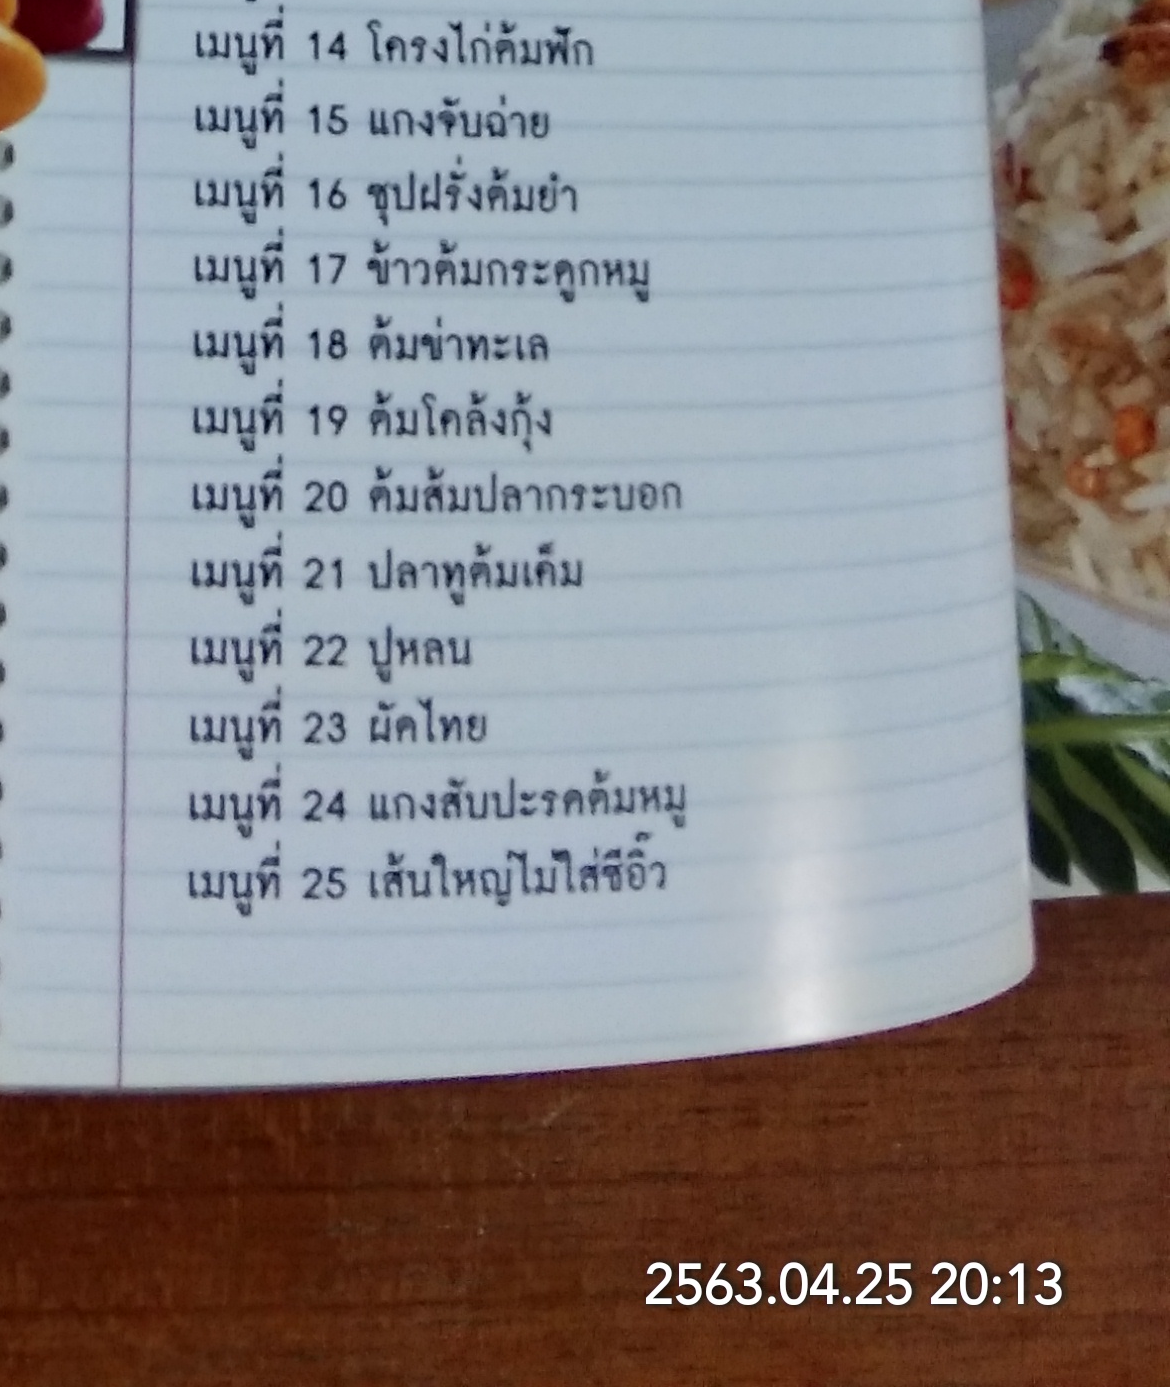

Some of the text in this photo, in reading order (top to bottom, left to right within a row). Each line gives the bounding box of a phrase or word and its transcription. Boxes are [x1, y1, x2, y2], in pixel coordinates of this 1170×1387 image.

[195, 4, 594, 76] เมนูที่ 14 โครงไก่ต้มฟัก
[194, 78, 550, 150] เมนูที่ 15 แกงจับฉ่าย
[194, 152, 284, 225] เมนูที่
[308, 177, 347, 210] 16
[194, 226, 650, 304] เมนูที่ 17 ข้าวต้มกระดูกหมู
[193, 302, 549, 376] เมนูที่ 18 ต้มข่าทะเล
[193, 378, 552, 454] เมนูที่ 19 ต้มโคล้งกุ้ง
[192, 454, 682, 529] เมนูที่ 20 ต้มส้มปลากระบอก
[190, 530, 583, 607] เมนูที่ 21 ปลาทูต้มเค็ม
[190, 607, 472, 684] เมนูที่ 22 ปูหลน
[190, 685, 487, 761] เมนูที่ 23 ผัดไทย
[189, 762, 686, 839] เมนูที่ 24 แกงสับปะรดต้มหมู
[188, 840, 281, 917] เมนูที่
[302, 866, 347, 900] 25
